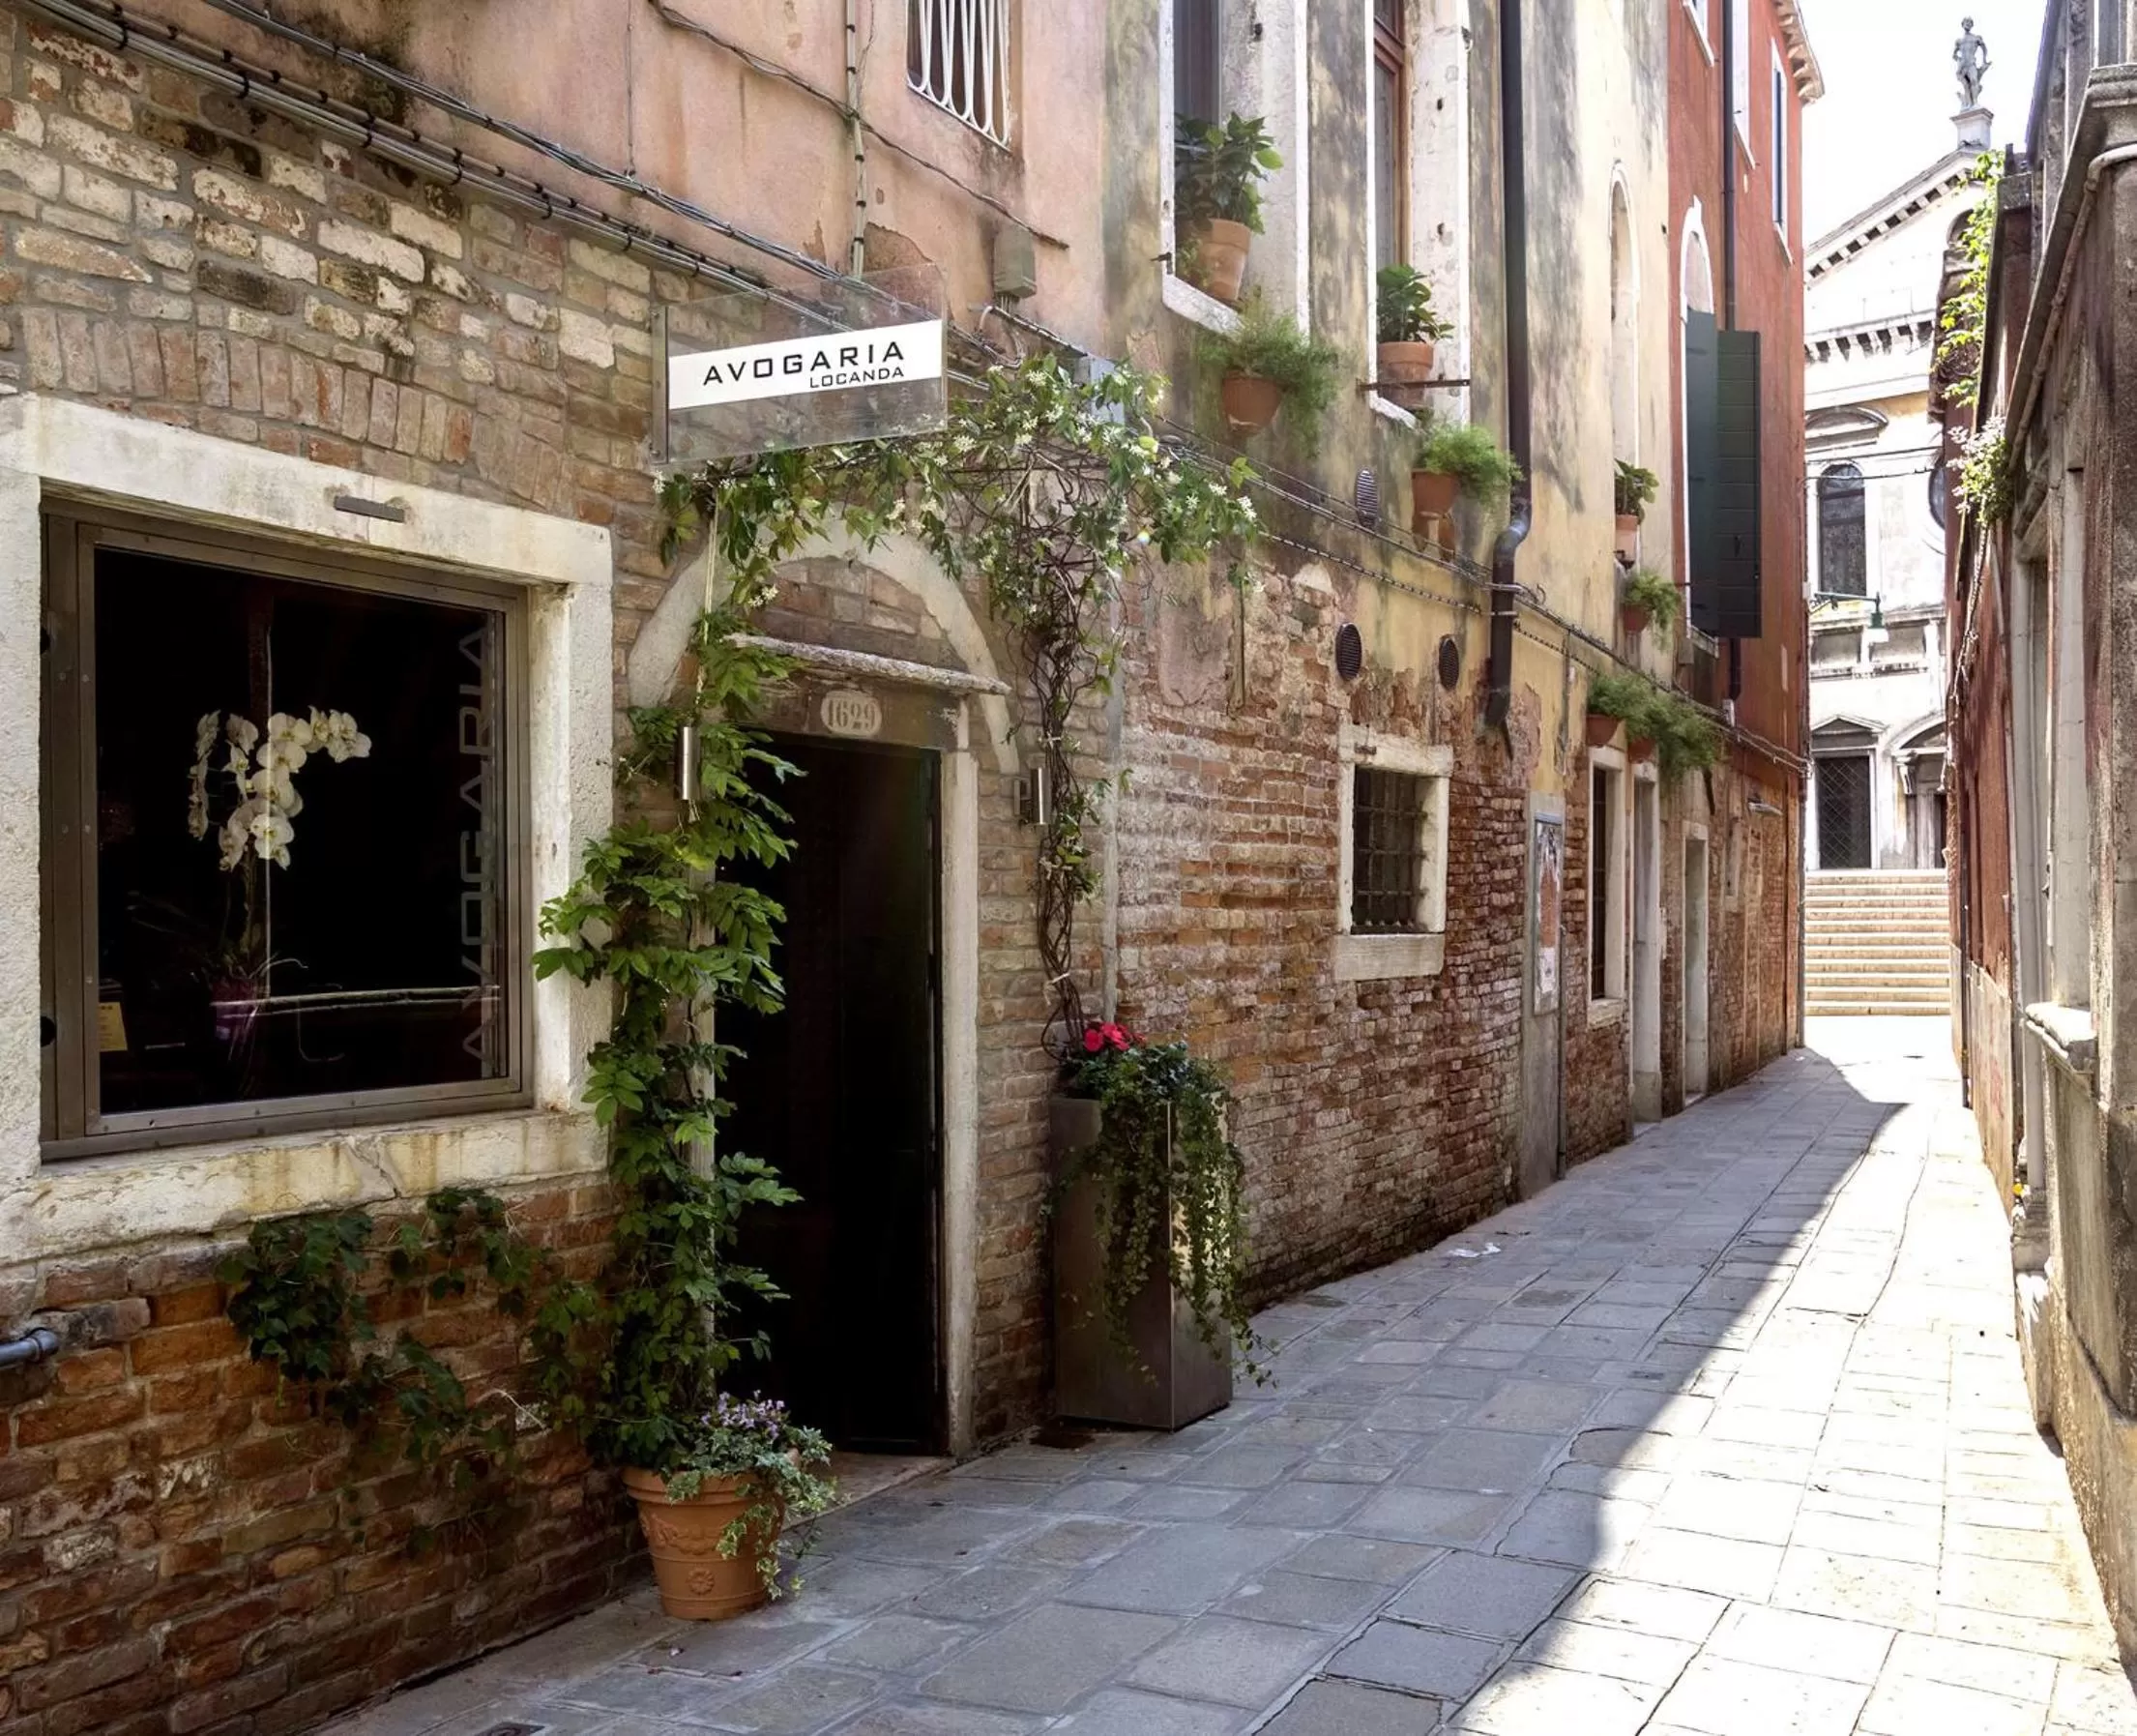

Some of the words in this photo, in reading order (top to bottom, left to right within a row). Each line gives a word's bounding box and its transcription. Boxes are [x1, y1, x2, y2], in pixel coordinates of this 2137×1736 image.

[703, 341, 904, 386] AVOGARIA
[809, 367, 904, 389] LOCANDA
[827, 698, 877, 730] 1629
[458, 626, 496, 1066] AVOGARIA
